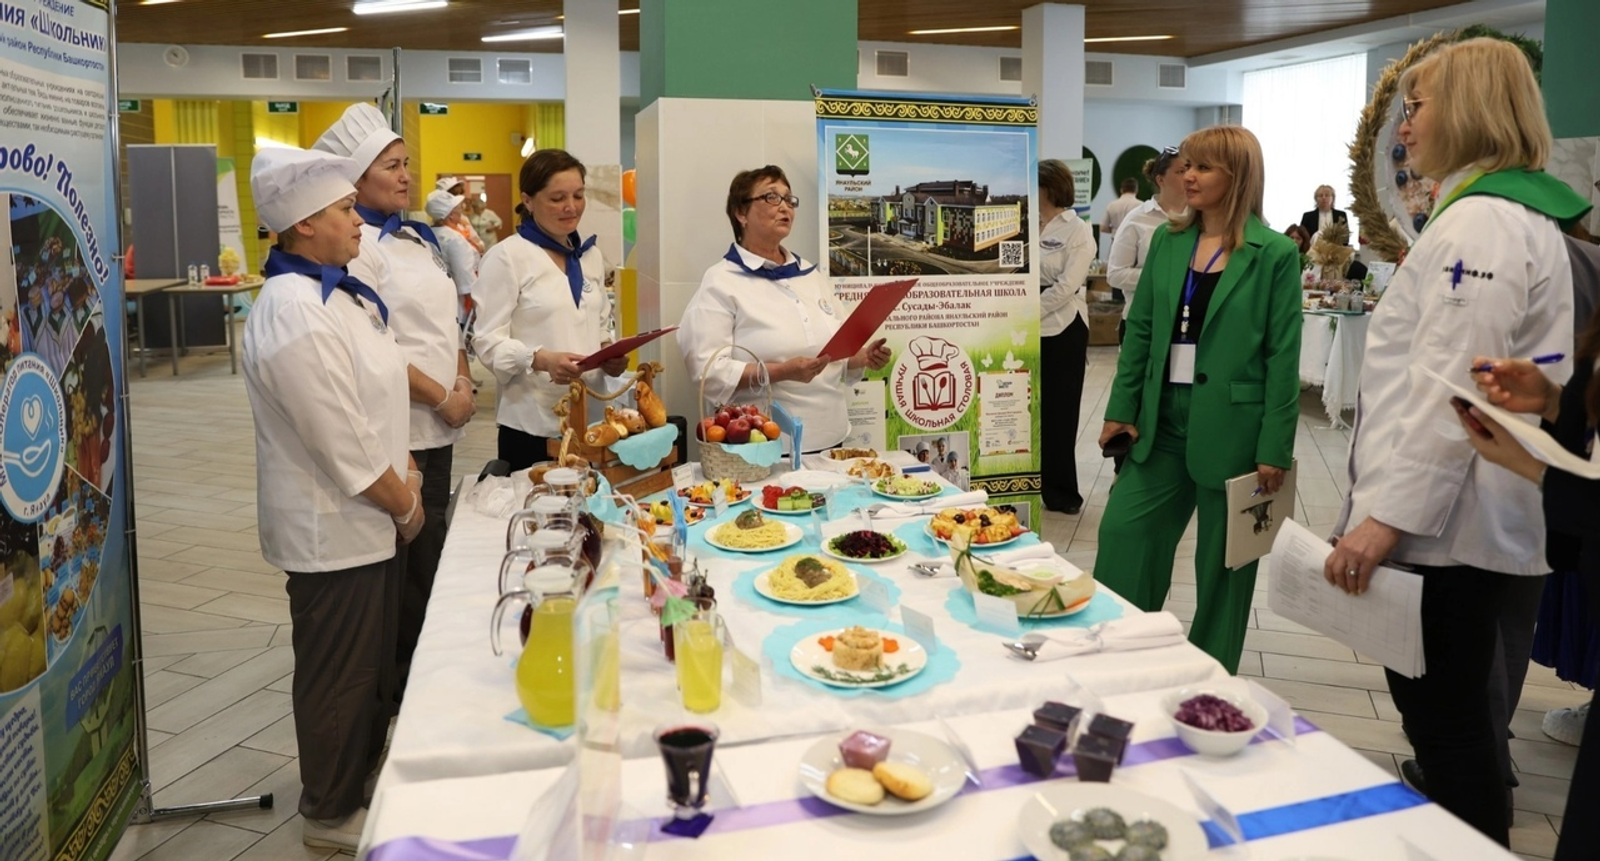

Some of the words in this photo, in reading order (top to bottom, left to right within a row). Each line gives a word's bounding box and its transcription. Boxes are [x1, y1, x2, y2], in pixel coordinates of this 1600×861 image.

[0, 3, 25, 27] ИЯ
[33, 0, 75, 17] ЕЖДЕНИЕ
[56, 160, 109, 283] Полезно!
[834, 291, 870, 301] РЕДН
[904, 289, 992, 299] ОБРАЗОВАТЕЛЬНАЯ
[994, 288, 1027, 297] ШКОЛА
[902, 301, 972, 312] Сусады-Эбалак
[919, 313, 944, 321] РАЙОНА
[945, 311, 987, 320] ЯНАУЛЬСКИЙ
[987, 311, 1008, 319] РАЙОН
[884, 323, 928, 331] РЕСПУБЛИКИ
[928, 321, 980, 329] БАШКОРТОСТАН
[17, 359, 45, 375] питания
[895, 363, 907, 408] ЛУЧШАЯ
[904, 408, 956, 428] ШКОЛЬНАЯ
[956, 361, 972, 413] СТОЛОВАЯ
